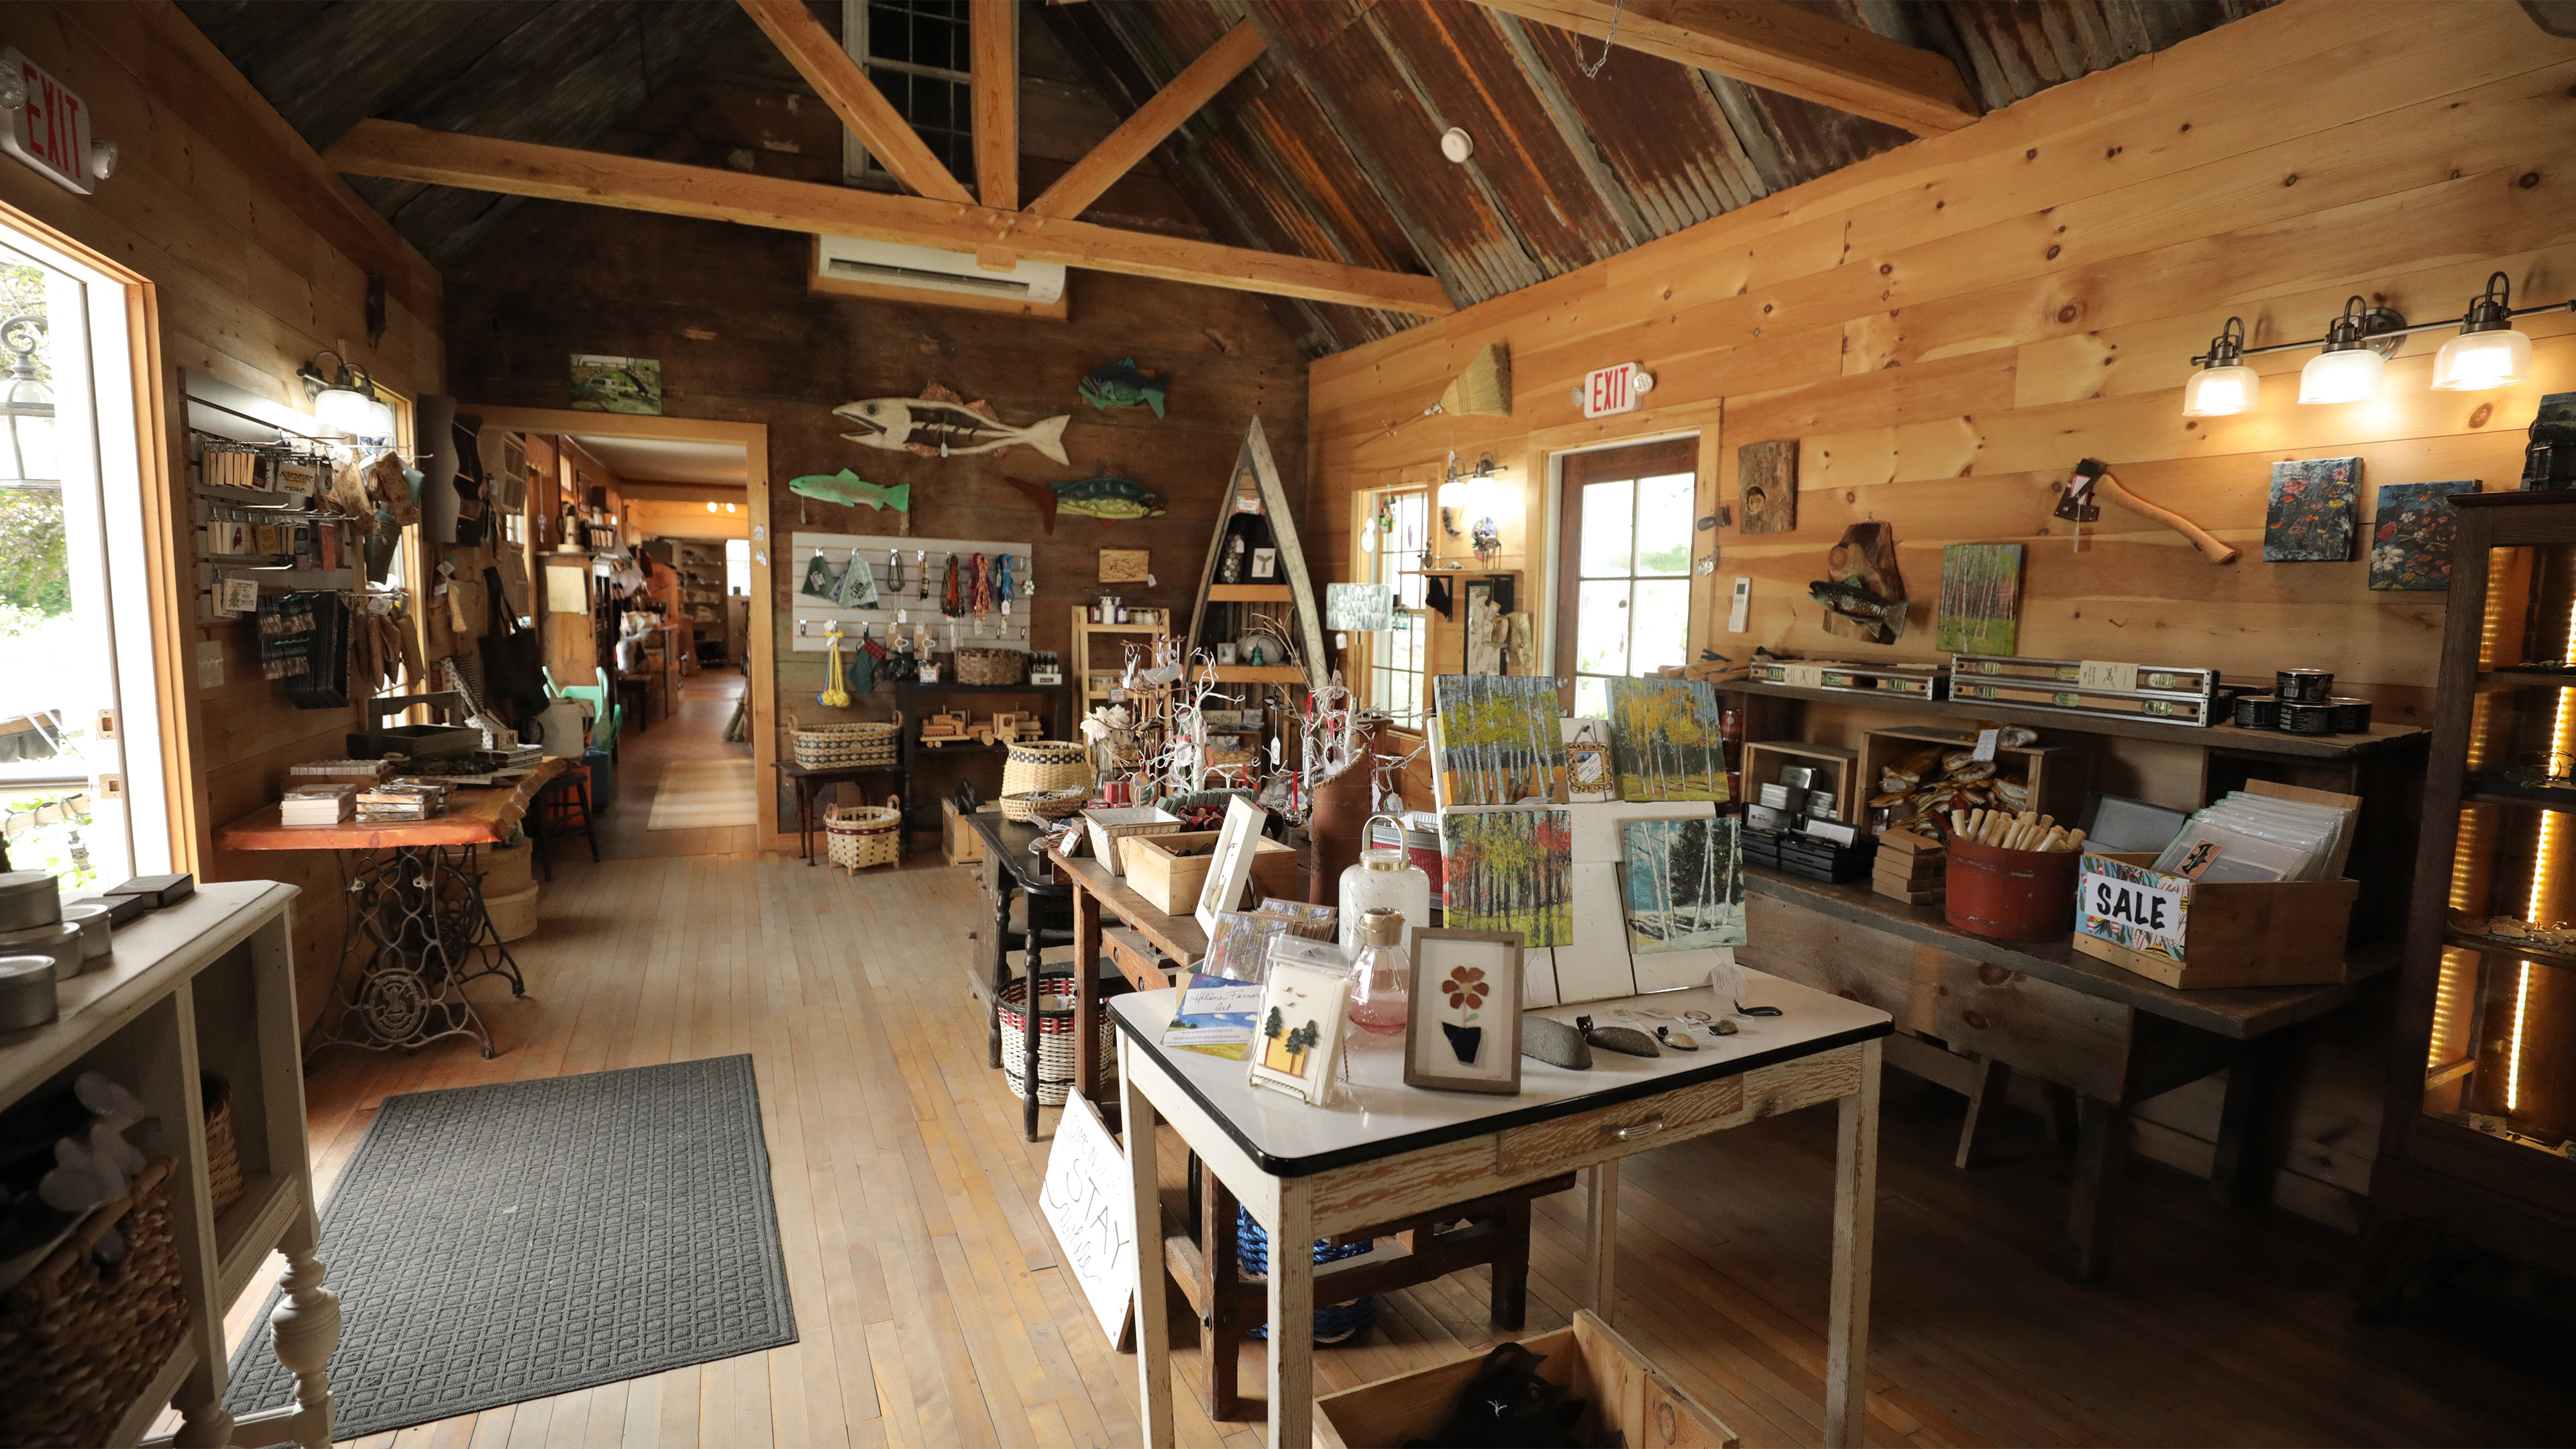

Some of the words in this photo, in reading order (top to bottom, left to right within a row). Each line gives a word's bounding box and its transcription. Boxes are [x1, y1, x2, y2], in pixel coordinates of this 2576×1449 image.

[22, 61, 81, 179] EXIT
[1593, 366, 1629, 412] EXIT
[2096, 882, 2166, 930] SALE
[1190, 991, 1228, 1004] Hélène
[1227, 989, 1260, 1001] Farrar
[1215, 1003, 1232, 1012] Art
[1067, 1158, 1130, 1269] STAY
[1051, 1194, 1101, 1283] awhile
